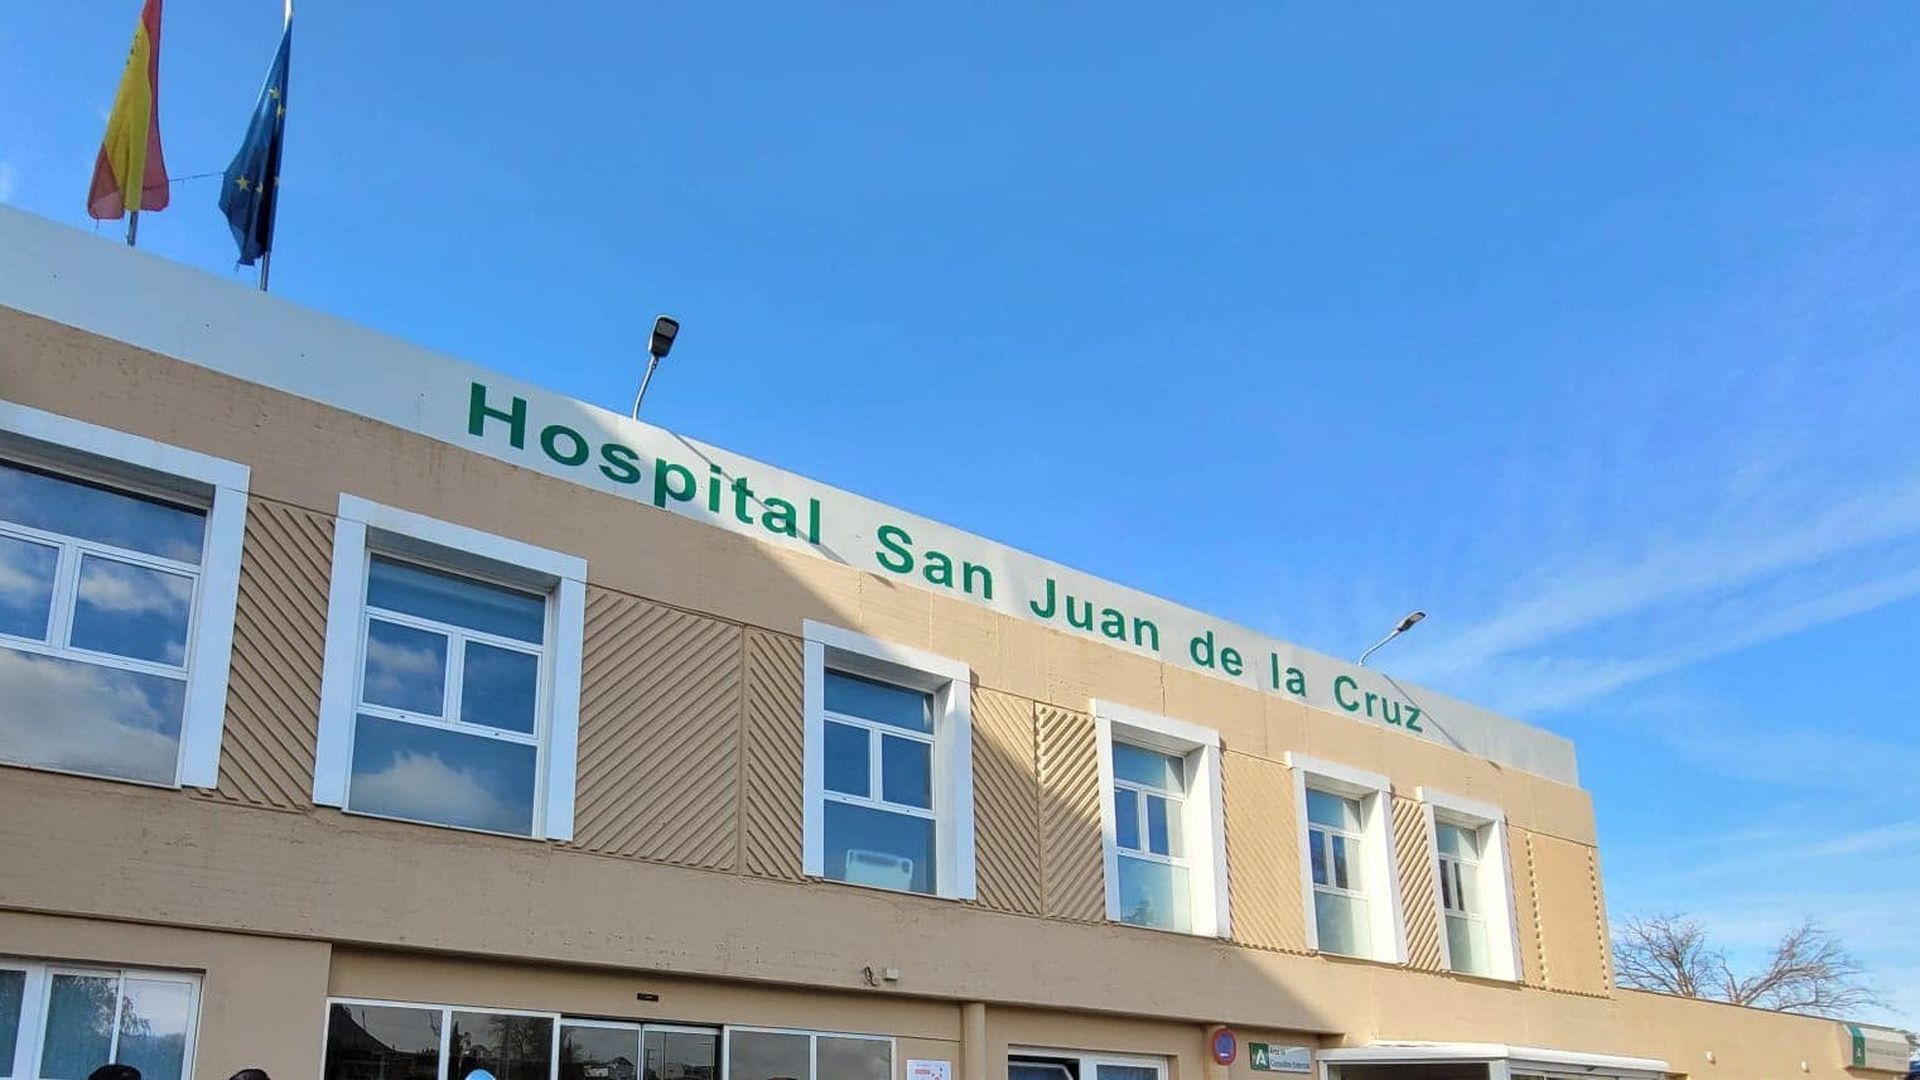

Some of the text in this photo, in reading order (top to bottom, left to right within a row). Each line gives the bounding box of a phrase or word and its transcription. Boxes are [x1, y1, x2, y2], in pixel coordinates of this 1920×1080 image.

[467, 382, 1421, 731] Hospital San Juan de la Cruz
